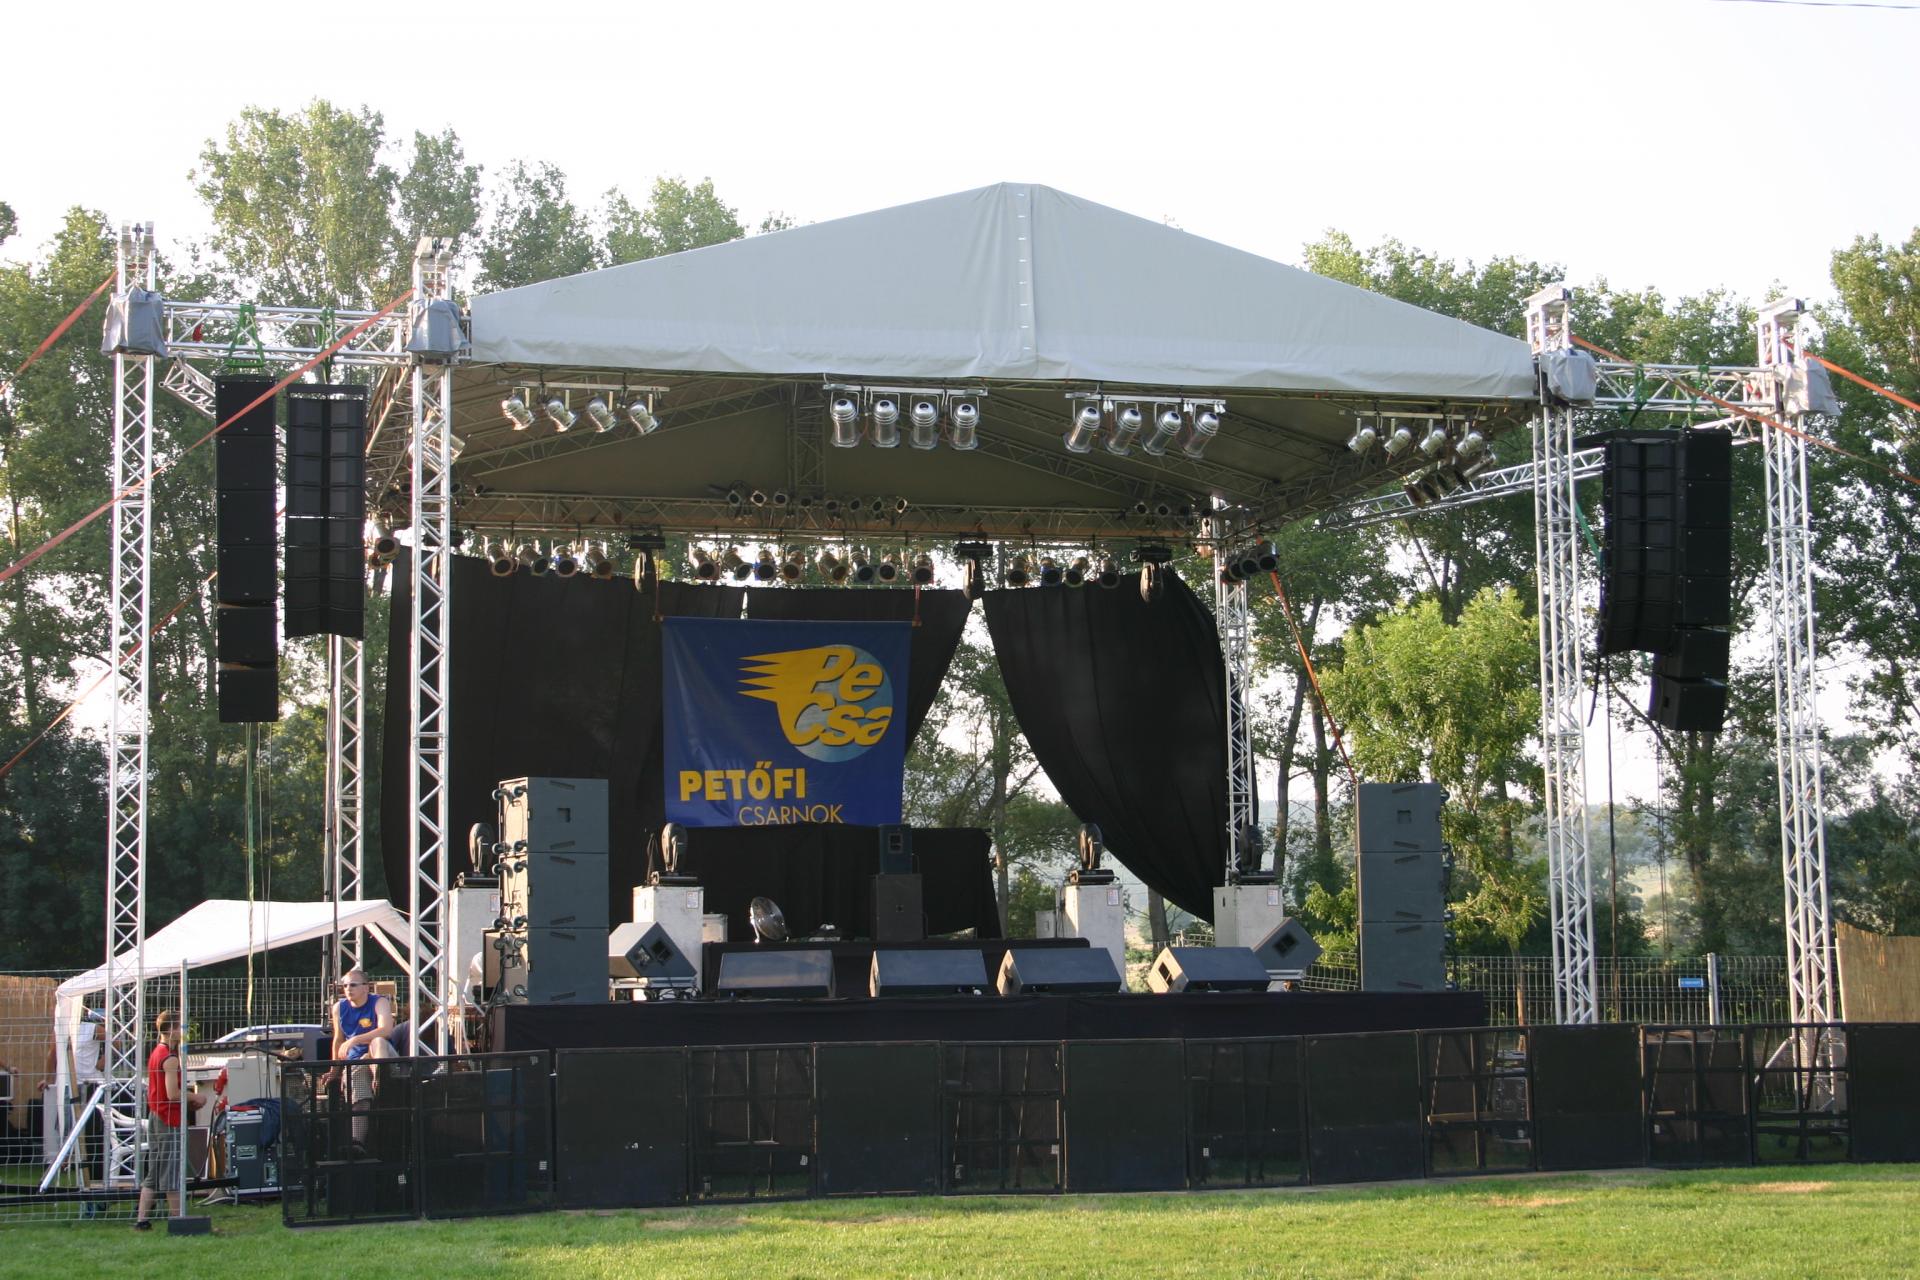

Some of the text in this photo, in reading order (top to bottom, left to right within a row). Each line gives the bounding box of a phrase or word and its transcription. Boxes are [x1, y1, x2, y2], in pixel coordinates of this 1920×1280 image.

[802, 646, 884, 702] Pe
[777, 691, 893, 746] Csa
[679, 761, 805, 801] PETŐFI
[739, 804, 844, 826] CSARNOK
